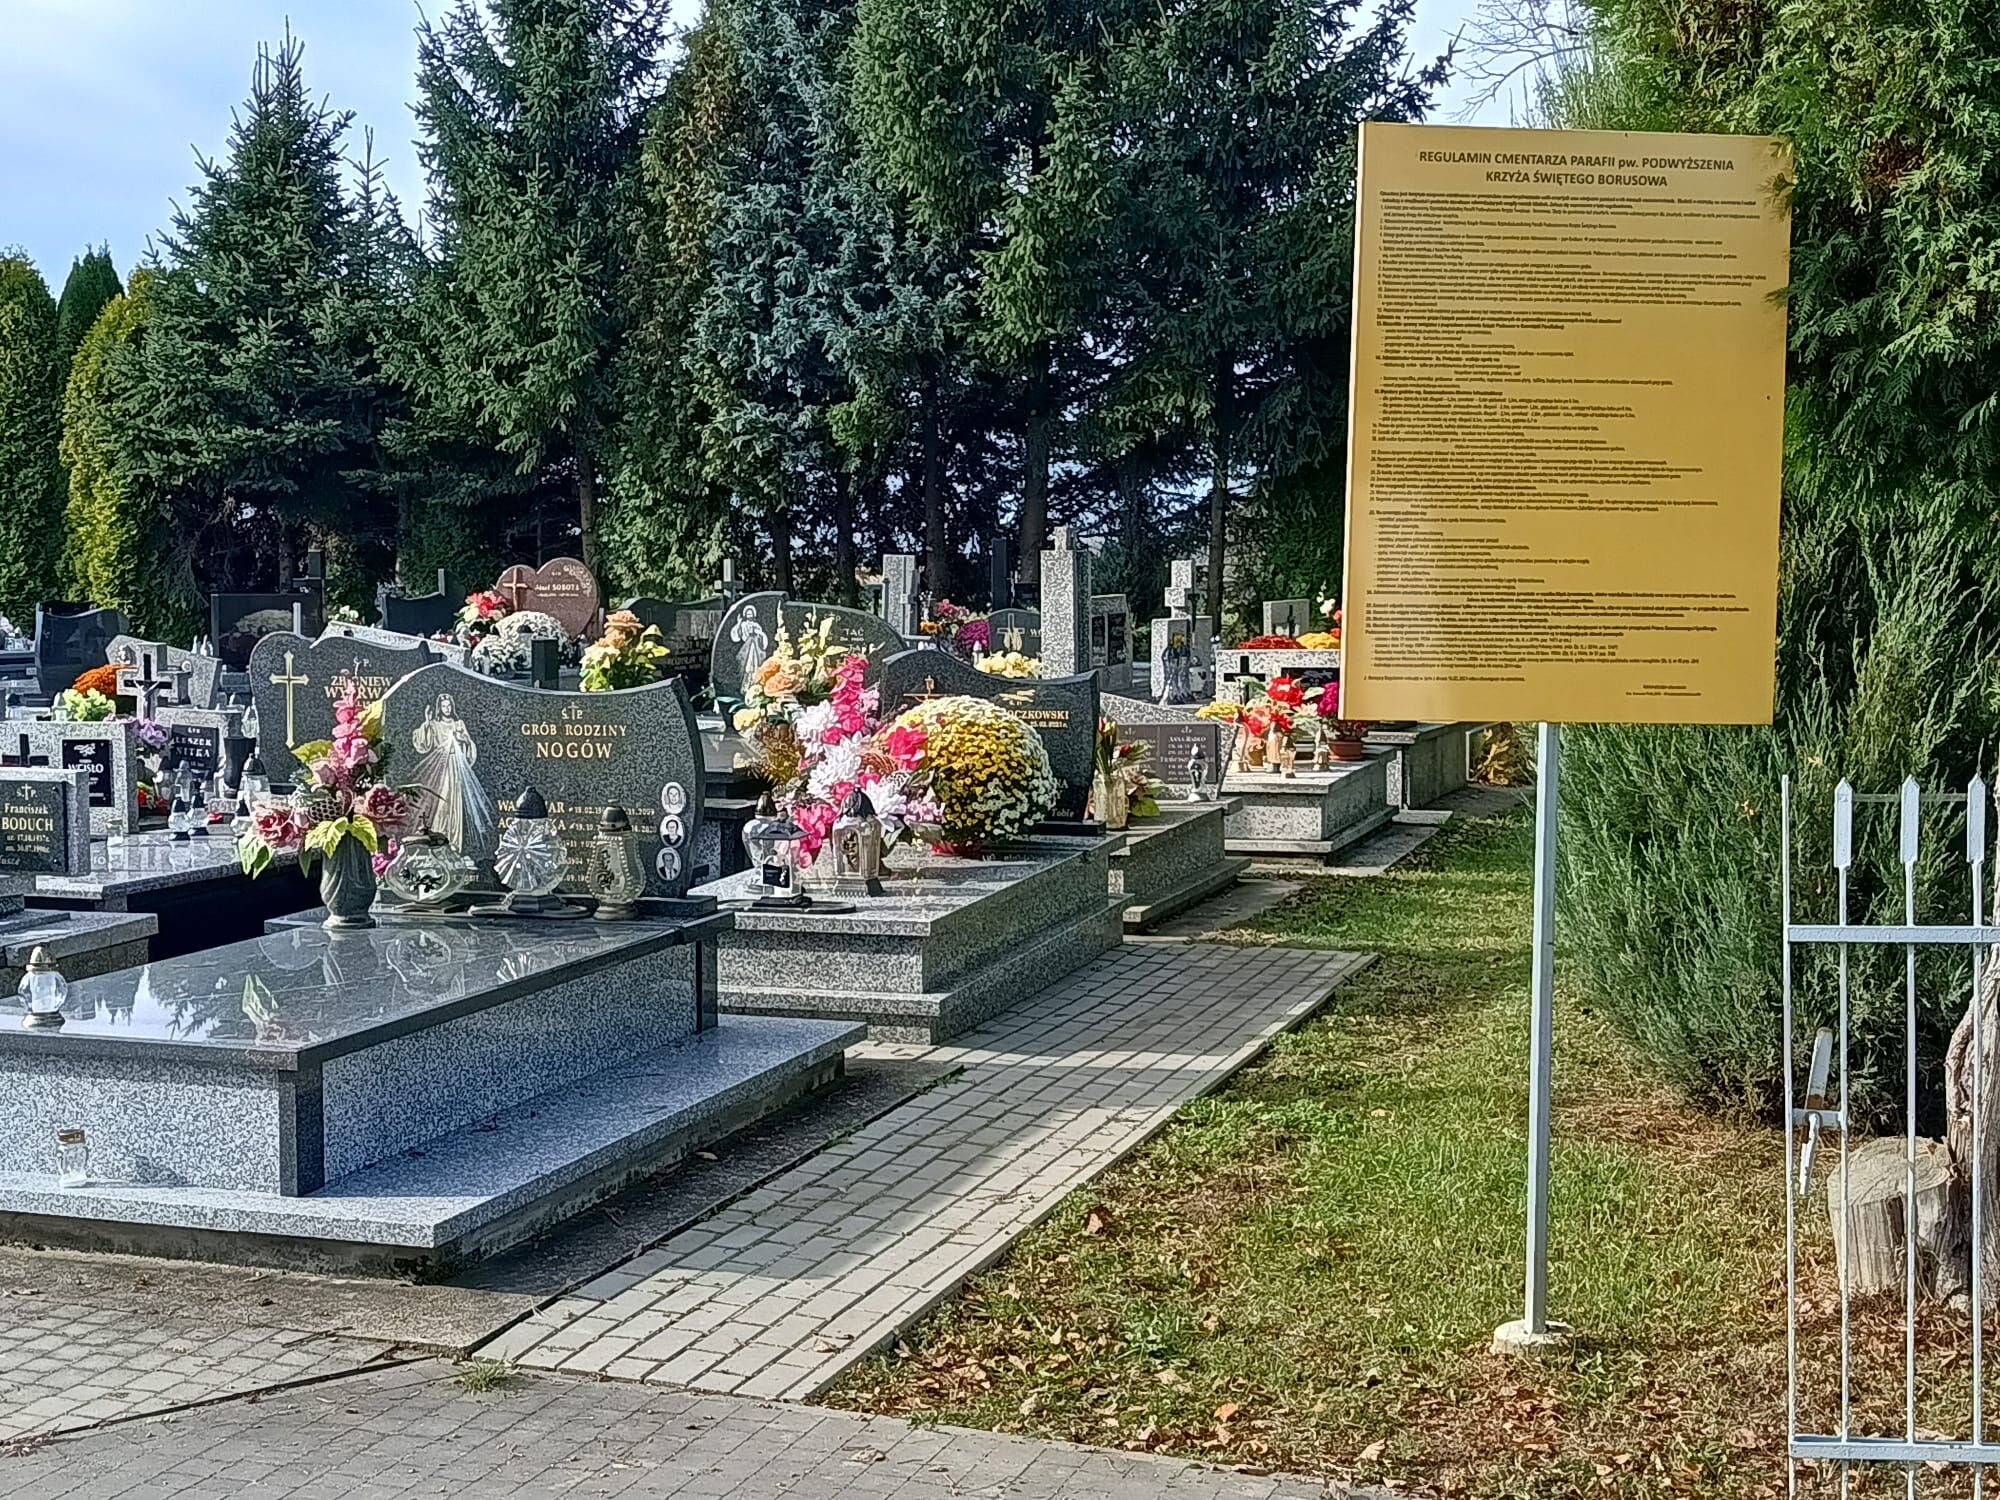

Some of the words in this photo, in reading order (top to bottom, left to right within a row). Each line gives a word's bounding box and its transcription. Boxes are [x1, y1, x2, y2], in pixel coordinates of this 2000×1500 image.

[1419, 151, 1492, 164] REGULAMIN
[1494, 153, 1567, 166] CMENTARZA
[1570, 155, 1615, 167] PARAFII
[1618, 158, 1639, 170] pw.
[1642, 156, 1734, 171] PODWYŻSZENIA
[1486, 170, 1530, 183] KRZYŻA
[1533, 170, 1595, 186] ŚWIĘTEGO
[1598, 174, 1668, 187] BORUSOWA
[552, 583, 580, 591] SOBOTA
[521, 721, 557, 736] GRÓB
[564, 724, 627, 737] RODZINY
[175, 736, 213, 747] LESZEK
[536, 739, 613, 759] NOGÓW
[4, 803, 49, 815] Franciszek
[1051, 808, 1075, 817] Tobie
[1, 816, 54, 832] BODUCH
